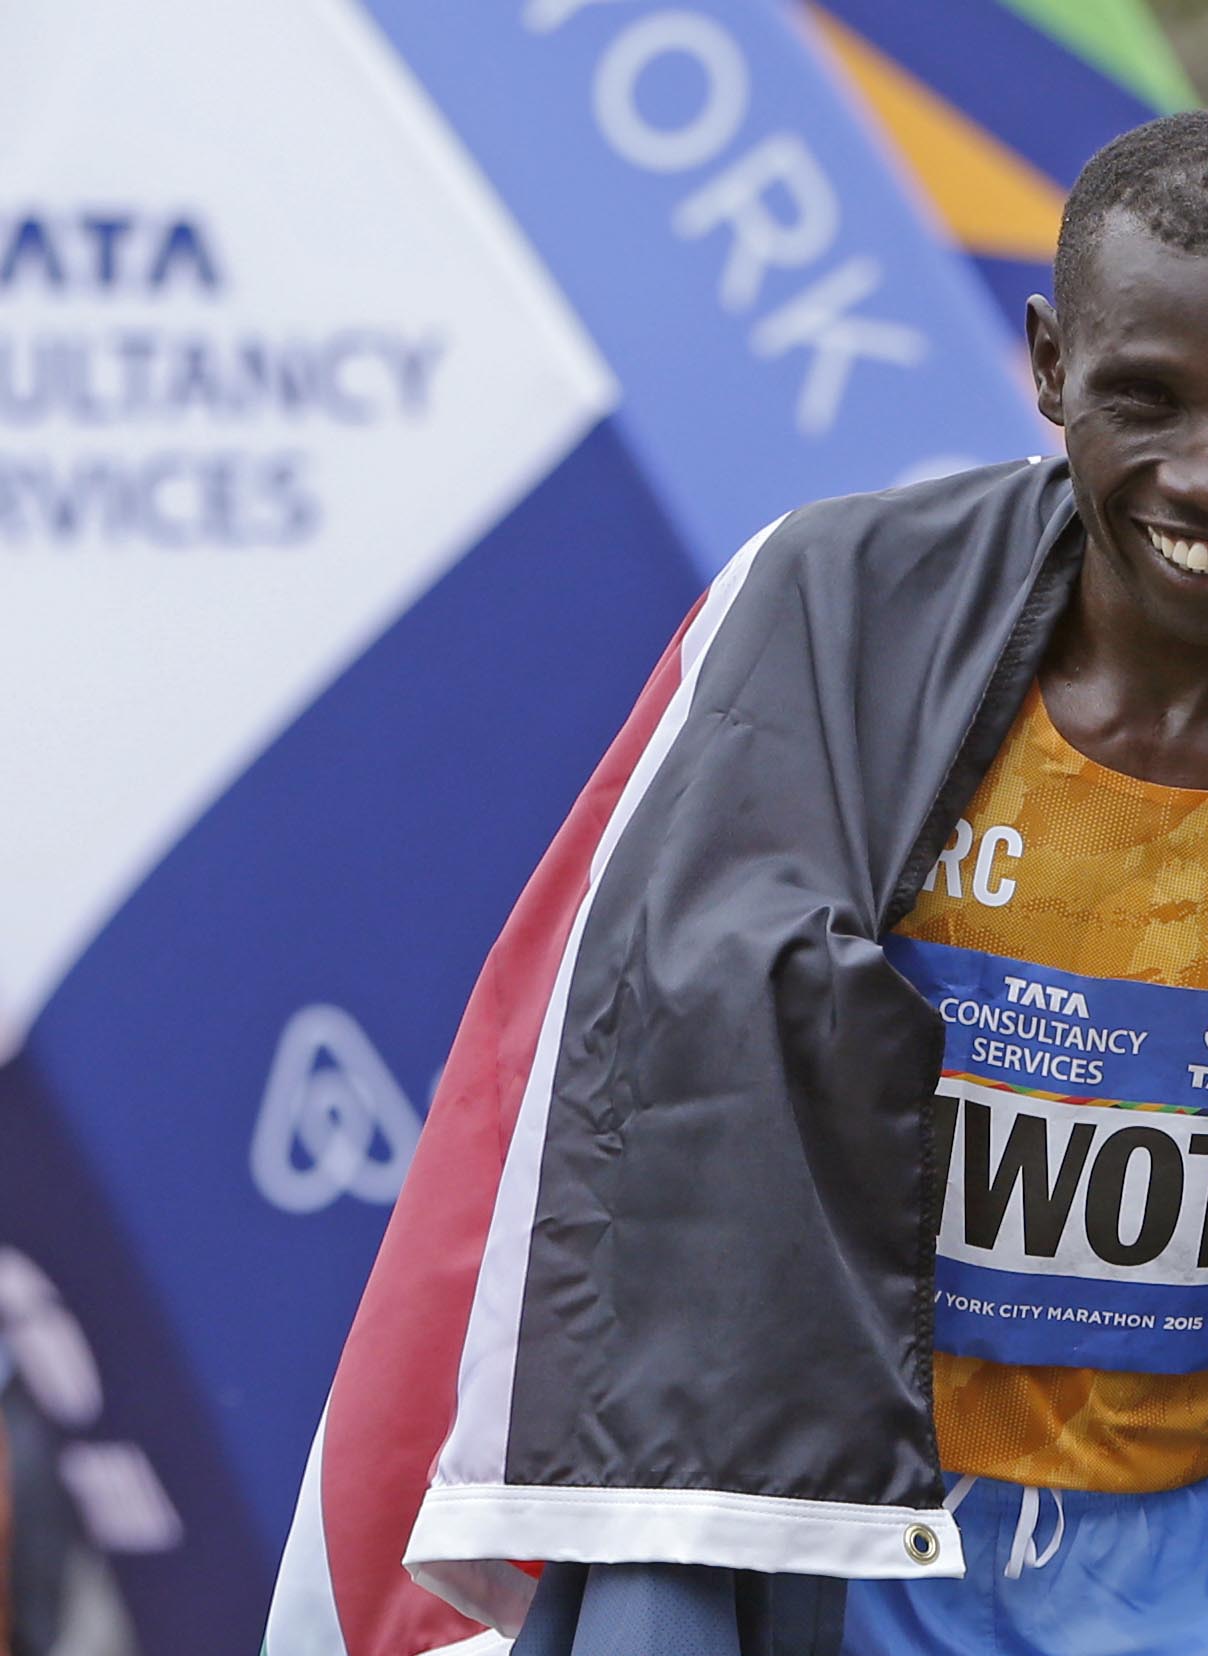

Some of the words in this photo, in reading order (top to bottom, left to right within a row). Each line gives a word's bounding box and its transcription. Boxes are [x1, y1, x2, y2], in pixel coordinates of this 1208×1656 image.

[0, 214, 220, 290] ATA
[1004, 976, 1089, 1019] TATA
[940, 998, 1148, 1055] CONSULTANCY
[972, 1037, 1104, 1085] SERVICES
[945, 1292, 995, 1317] YORK
[999, 1304, 1043, 1320] CITY
[1047, 1307, 1155, 1329] MARATHON
[1163, 1316, 1203, 1330] 2015
